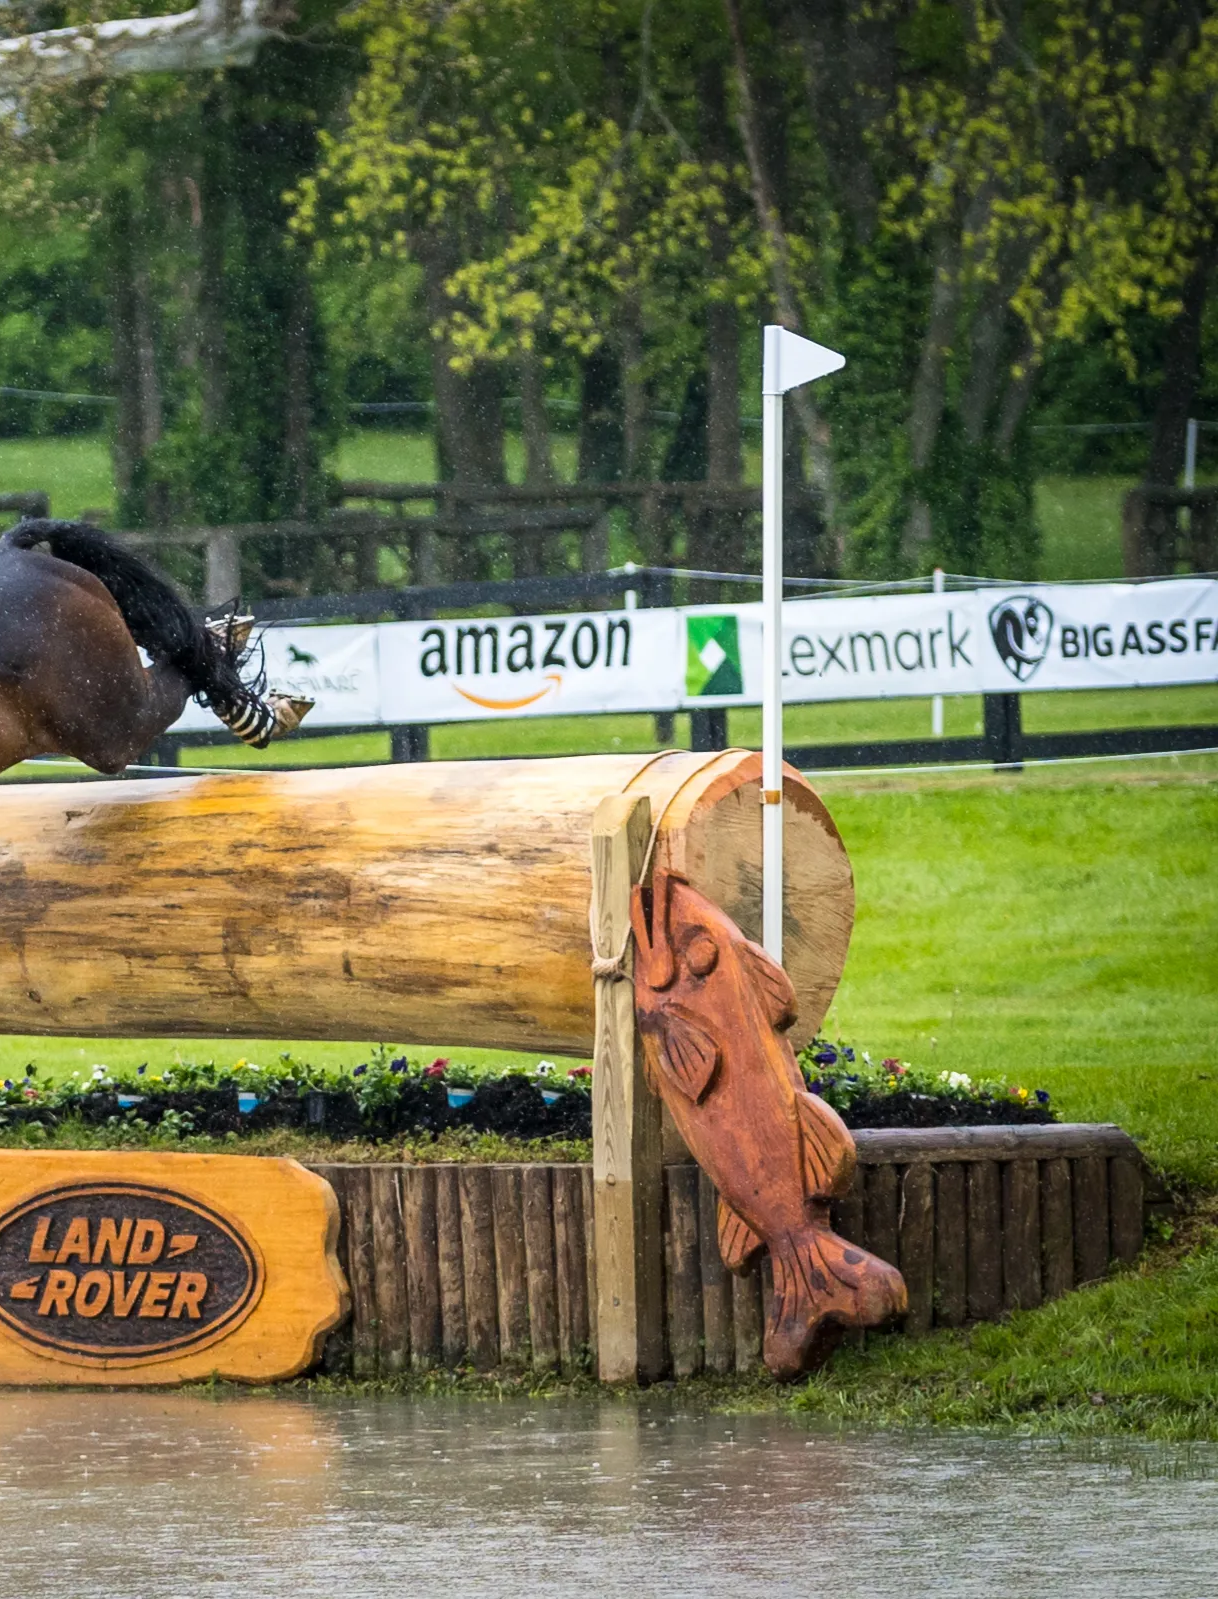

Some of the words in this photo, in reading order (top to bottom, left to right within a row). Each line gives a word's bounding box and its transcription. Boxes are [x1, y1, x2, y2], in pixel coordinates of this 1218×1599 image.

[420, 617, 632, 677] amazon
[761, 610, 974, 677] exmark
[1061, 622, 1113, 658] BIG
[1121, 619, 1188, 655] ASS
[28, 1217, 166, 1265] LAND
[38, 1269, 208, 1319] ROVER
